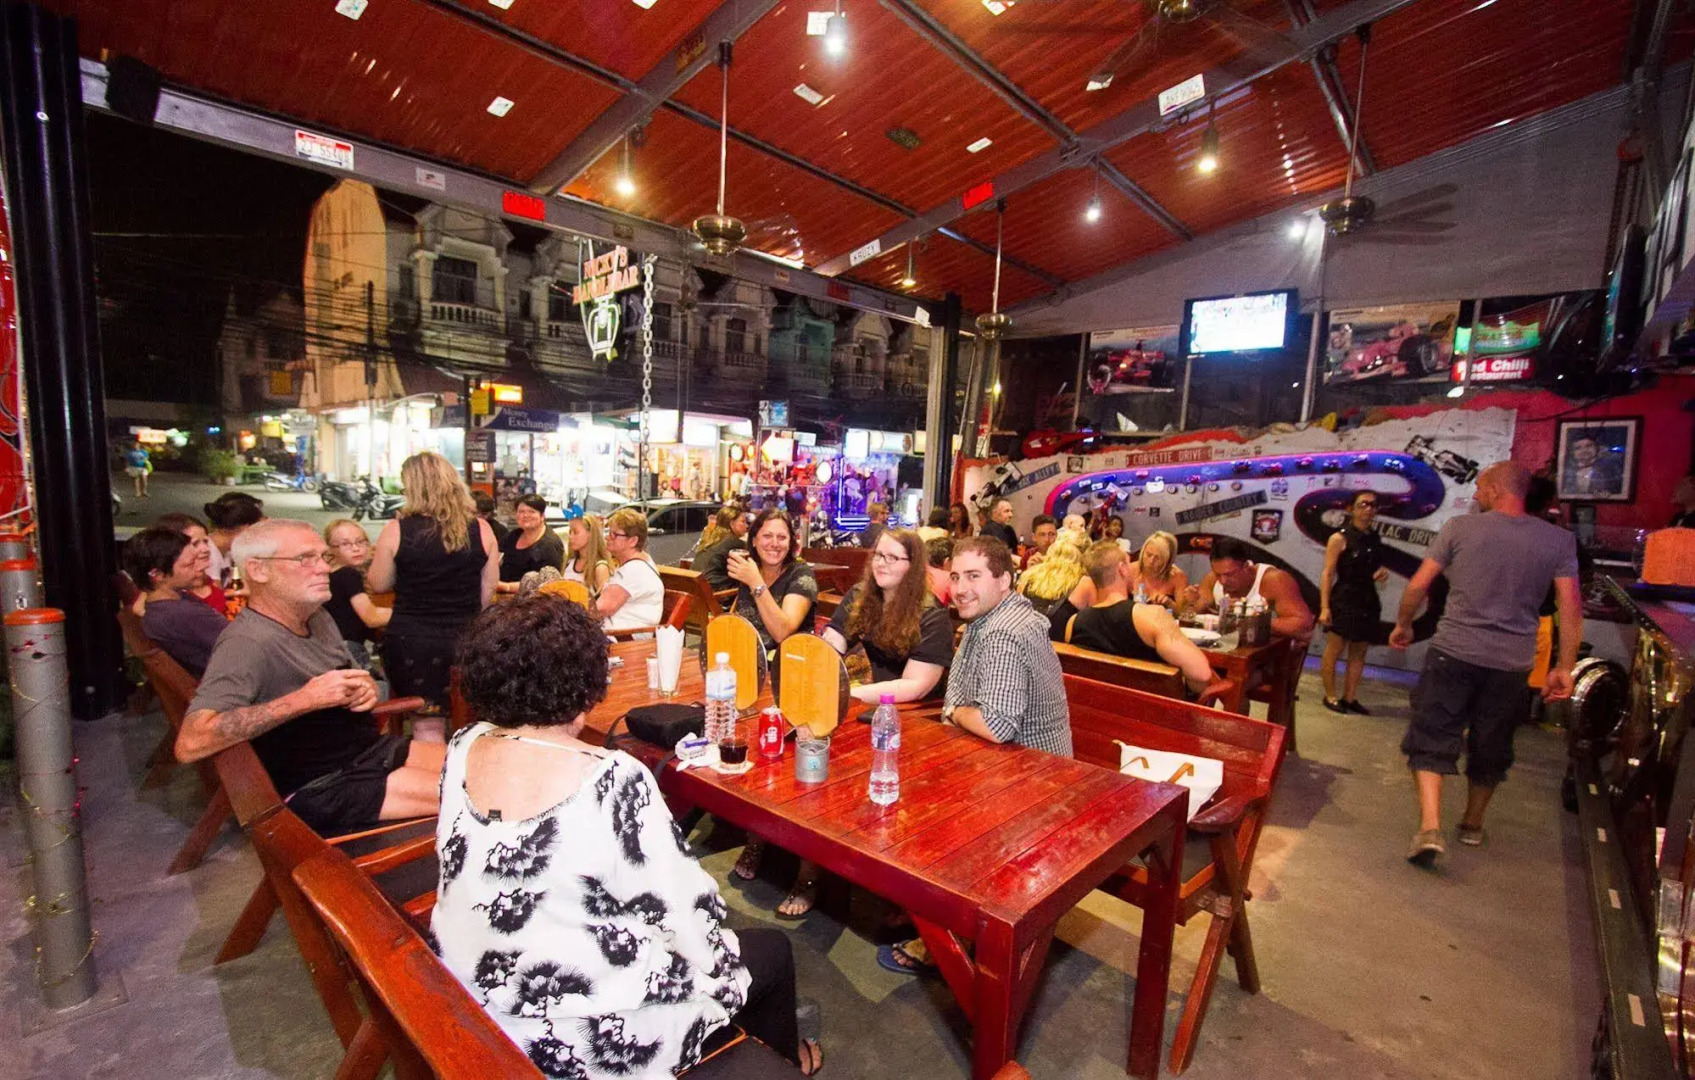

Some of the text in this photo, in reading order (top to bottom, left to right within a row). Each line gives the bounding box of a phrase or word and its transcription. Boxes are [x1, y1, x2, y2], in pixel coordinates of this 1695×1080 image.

[1490, 358, 1530, 372] Chilli
[502, 407, 528, 417] Money
[508, 417, 555, 430] Exchange
[1133, 451, 1173, 465] CORVETTE
[1178, 448, 1203, 461] DRIVE
[1408, 529, 1437, 546] DRIV
